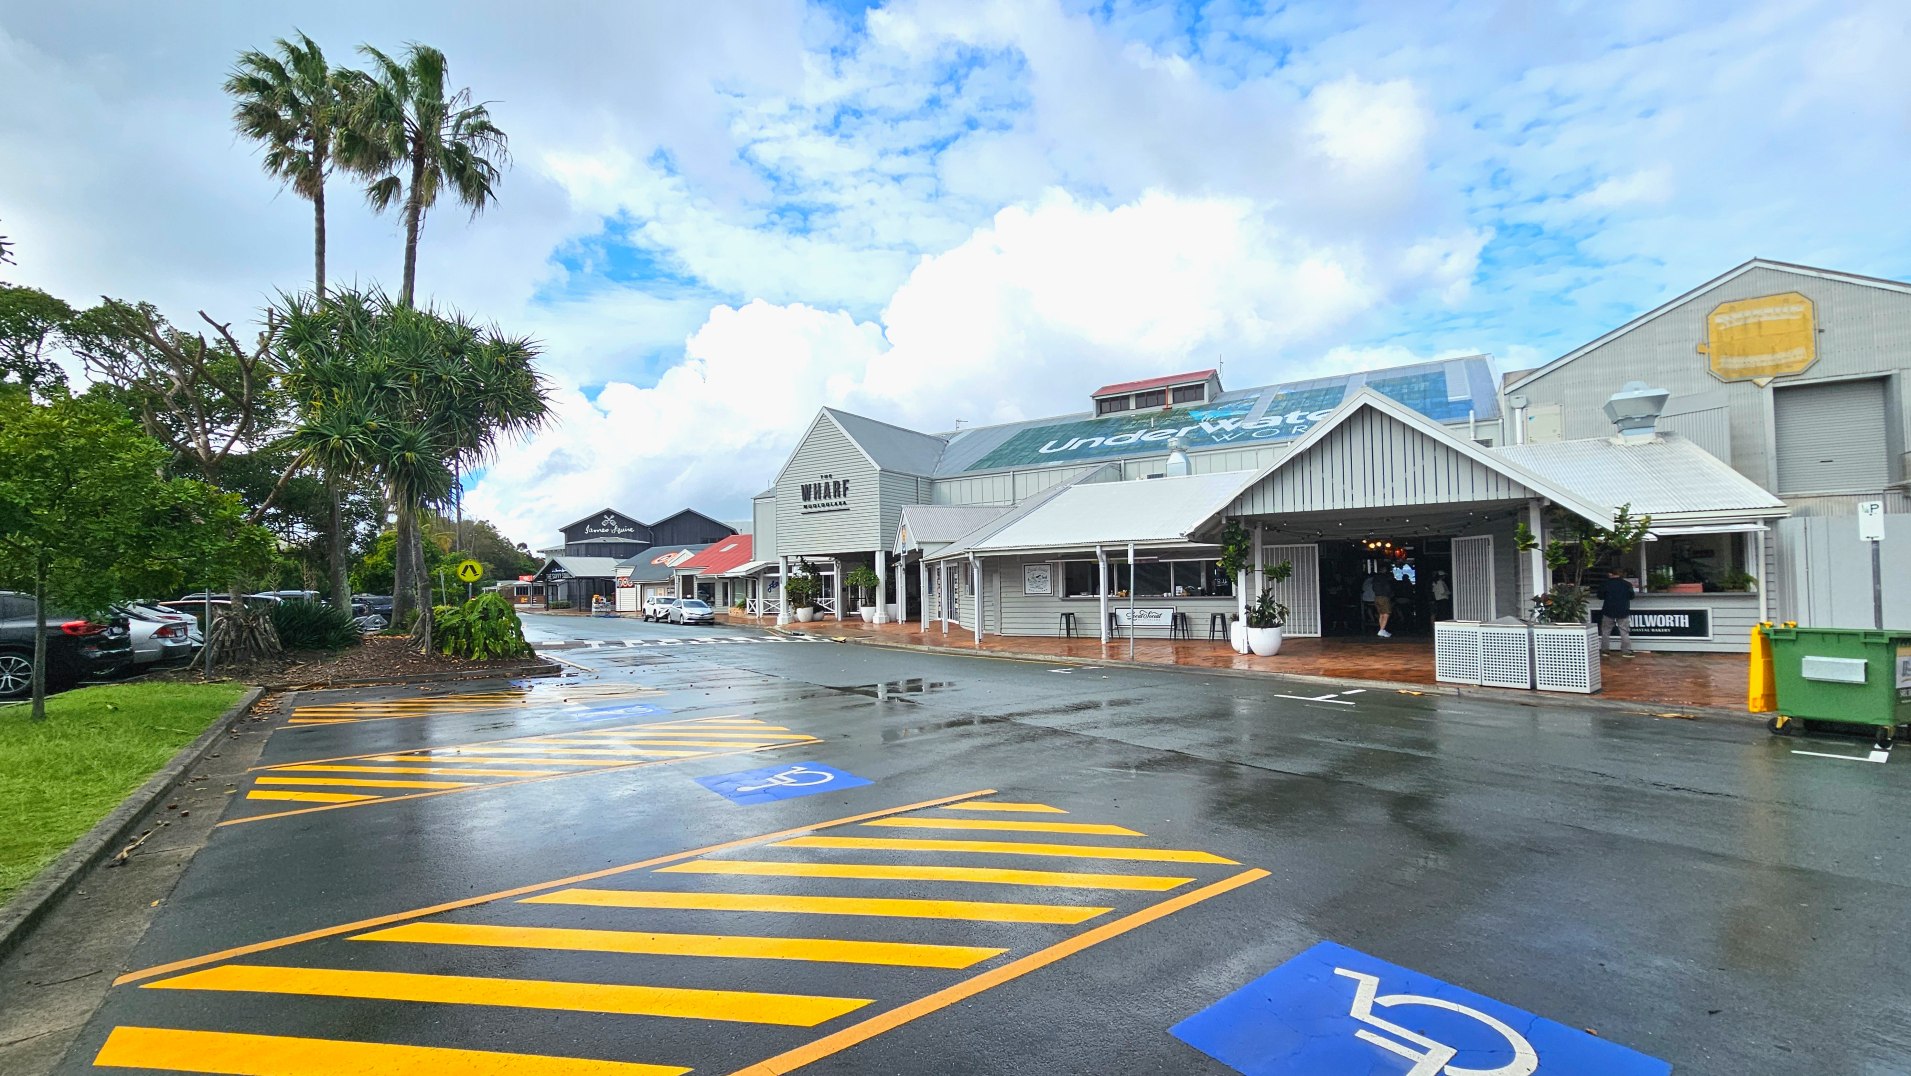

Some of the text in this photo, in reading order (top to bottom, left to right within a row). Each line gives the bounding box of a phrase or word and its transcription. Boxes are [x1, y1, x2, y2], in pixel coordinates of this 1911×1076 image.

[1211, 425, 1308, 442] WOR
[801, 479, 849, 502] WHARF
[803, 501, 847, 509] MOOLOOLABA
[584, 524, 610, 534] James
[1629, 614, 1689, 627] NILWORTH
